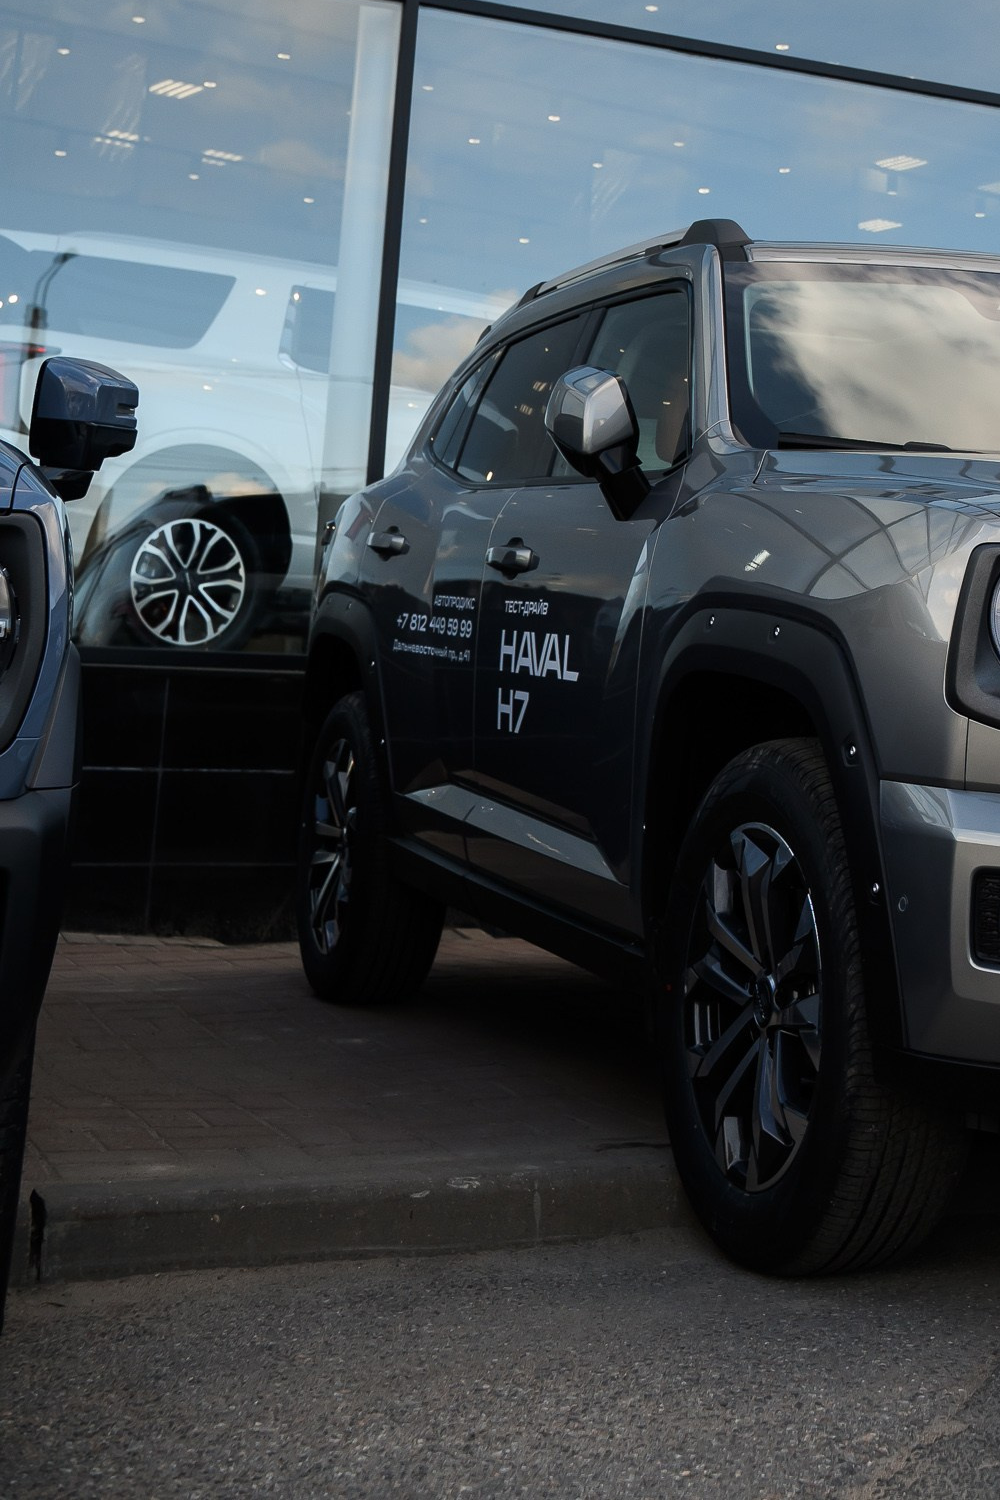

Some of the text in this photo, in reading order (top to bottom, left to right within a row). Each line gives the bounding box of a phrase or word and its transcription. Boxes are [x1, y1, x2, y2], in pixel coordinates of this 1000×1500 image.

[434, 595, 476, 610] АВТОПРОДИКС
[504, 599, 549, 617] ТЕСТ-ДРАЙВ
[397, 612, 473, 638] +7 812 449 59 99
[499, 629, 580, 682] HAVAL
[497, 687, 530, 734] H7
